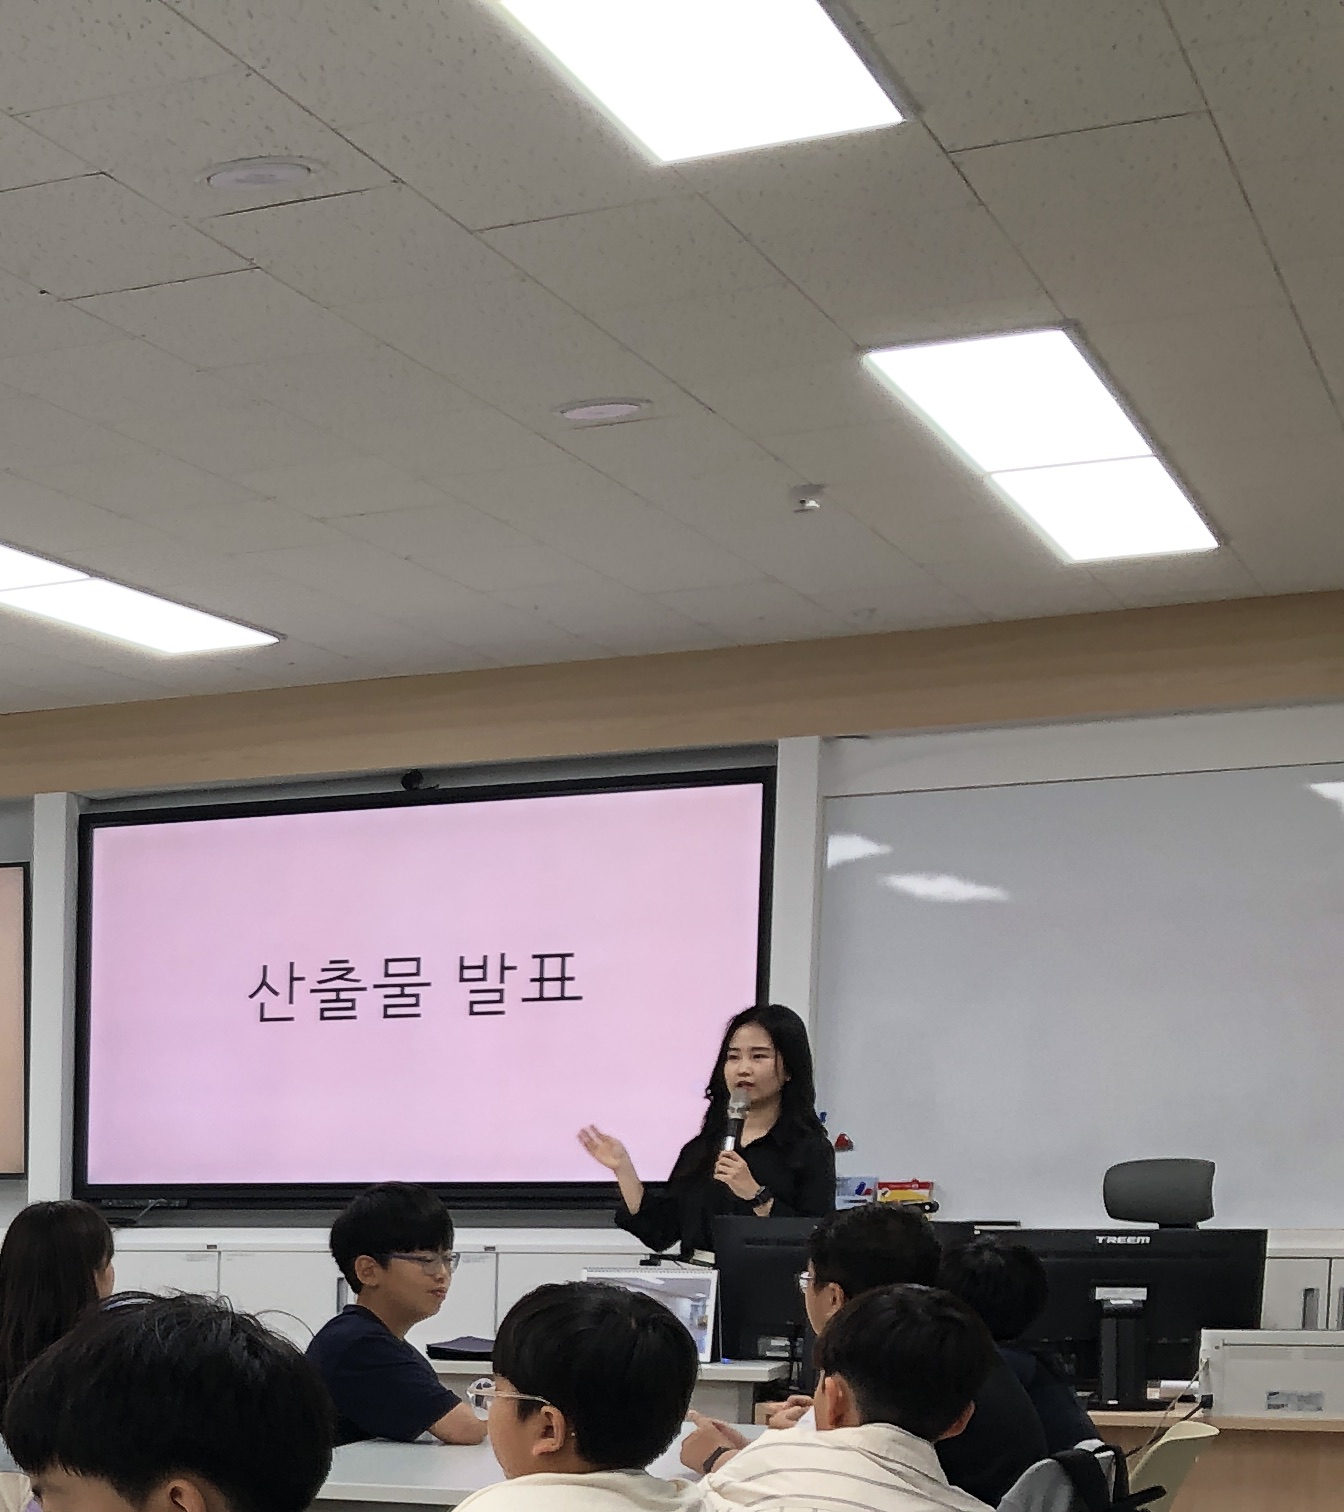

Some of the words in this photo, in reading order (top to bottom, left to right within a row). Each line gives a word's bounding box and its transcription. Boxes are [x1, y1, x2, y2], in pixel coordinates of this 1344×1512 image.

[249, 955, 433, 1024] 산출물
[458, 951, 585, 1017] 발표
[1095, 1235, 1152, 1245] TREEM
